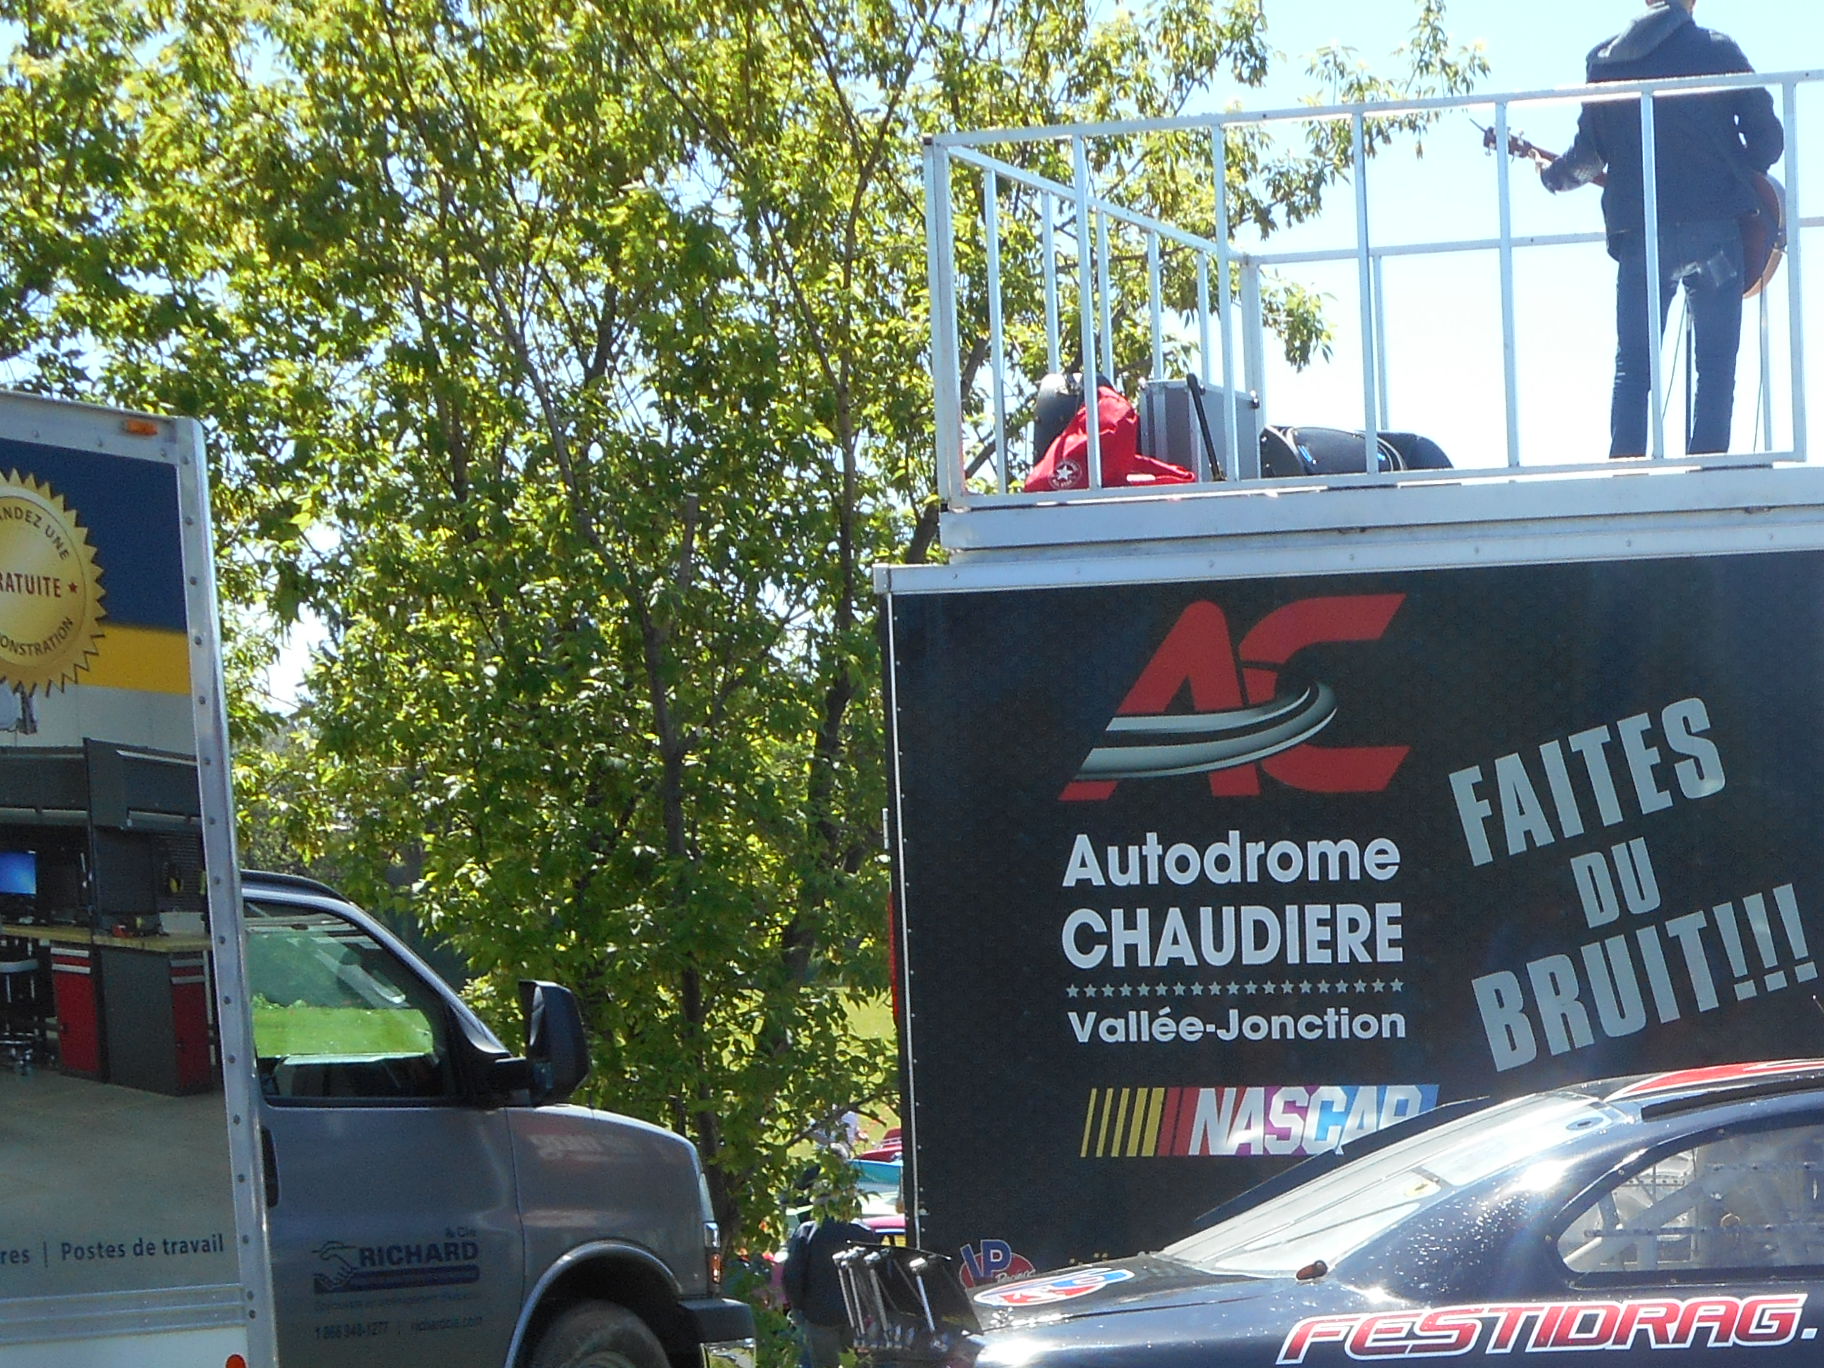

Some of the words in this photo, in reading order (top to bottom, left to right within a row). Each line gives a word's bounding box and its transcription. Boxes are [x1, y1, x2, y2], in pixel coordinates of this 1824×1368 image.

[0, 506, 42, 529] NDEZ
[44, 525, 70, 560] UNE
[1057, 593, 1410, 801] AC
[1448, 697, 1726, 867] FAITES
[1062, 830, 1401, 888] Autodrome
[1570, 837, 1662, 929] DU
[1061, 902, 1405, 970] CHAUDIERE
[1471, 883, 1819, 1073] BRUIT!!!
[1067, 1006, 1406, 1044] Vallée-Jonction
[61, 1242, 126, 1261] Postes
[133, 1237, 156, 1257] de
[163, 1233, 224, 1255] travail
[359, 1242, 479, 1267] RICHARD
